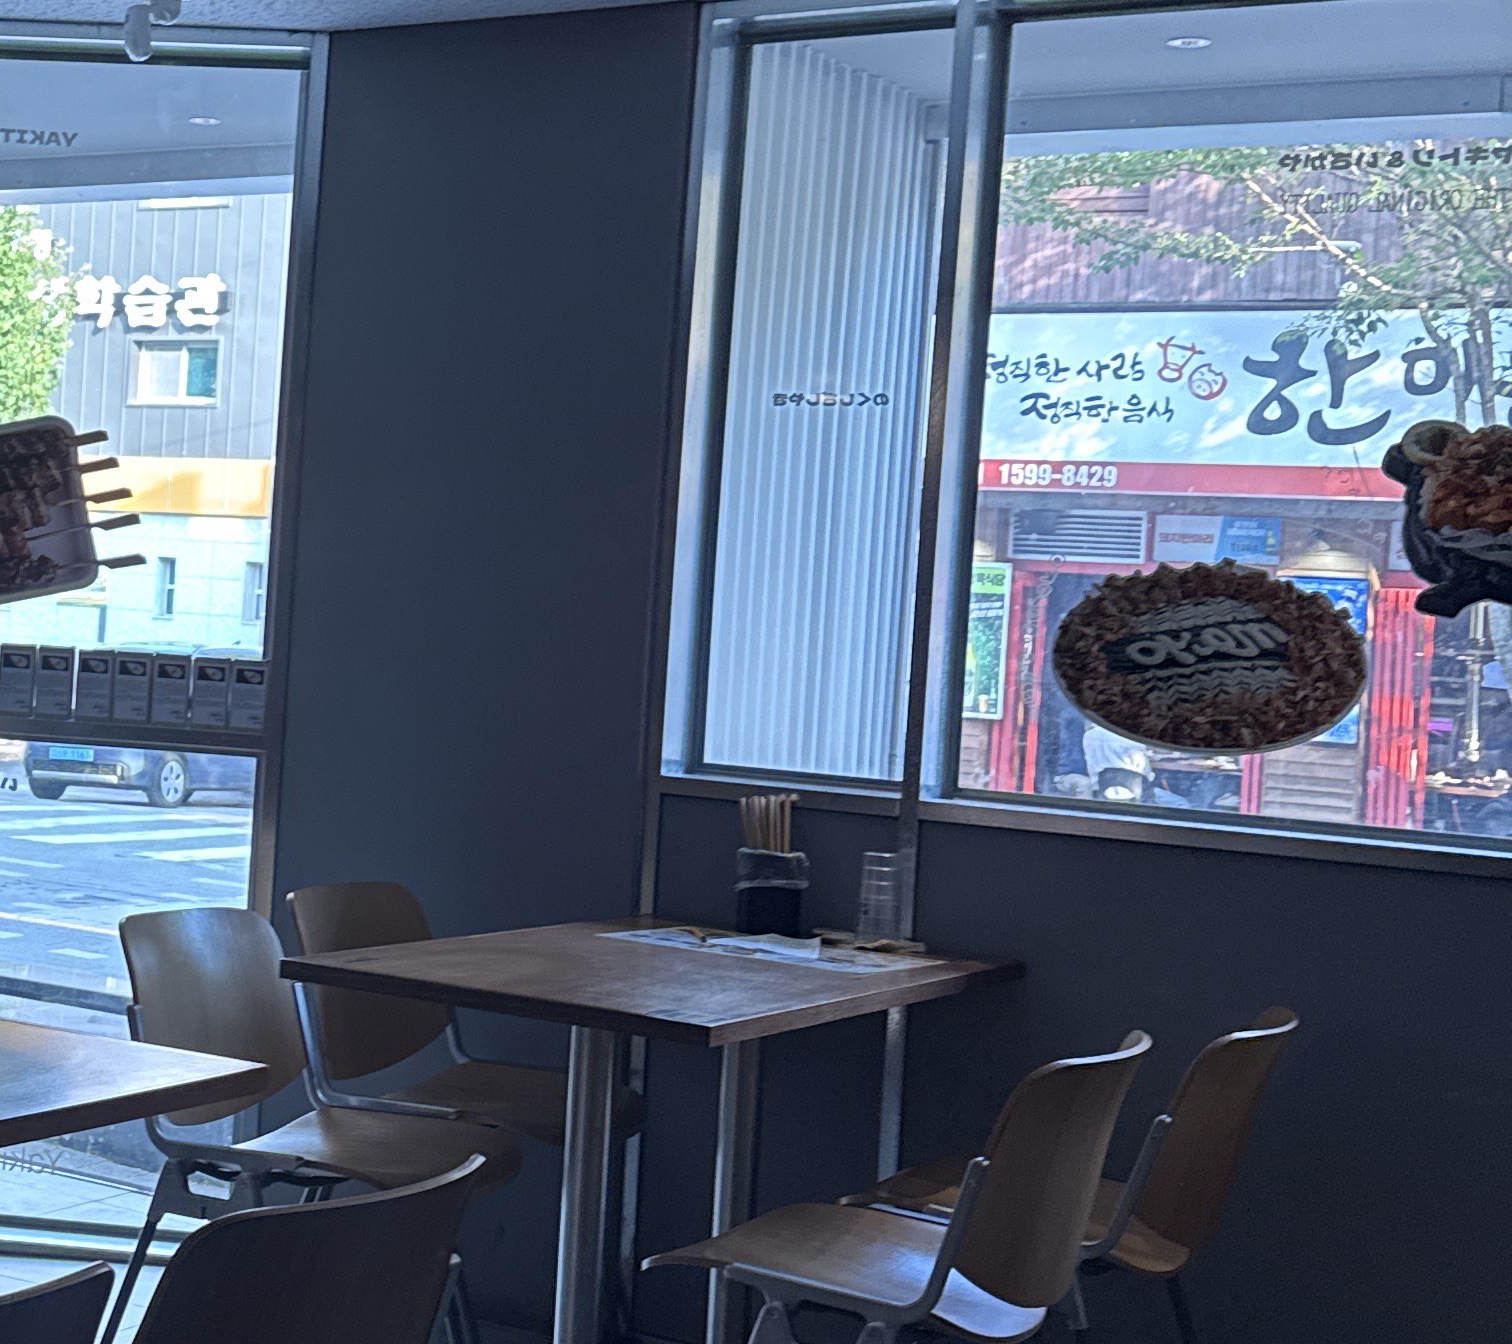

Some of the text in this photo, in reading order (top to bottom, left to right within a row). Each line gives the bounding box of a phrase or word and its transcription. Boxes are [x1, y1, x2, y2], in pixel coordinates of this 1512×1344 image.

[1020, 392, 1175, 424] 정직한 음식
[999, 463, 1118, 487] 1599-8429
